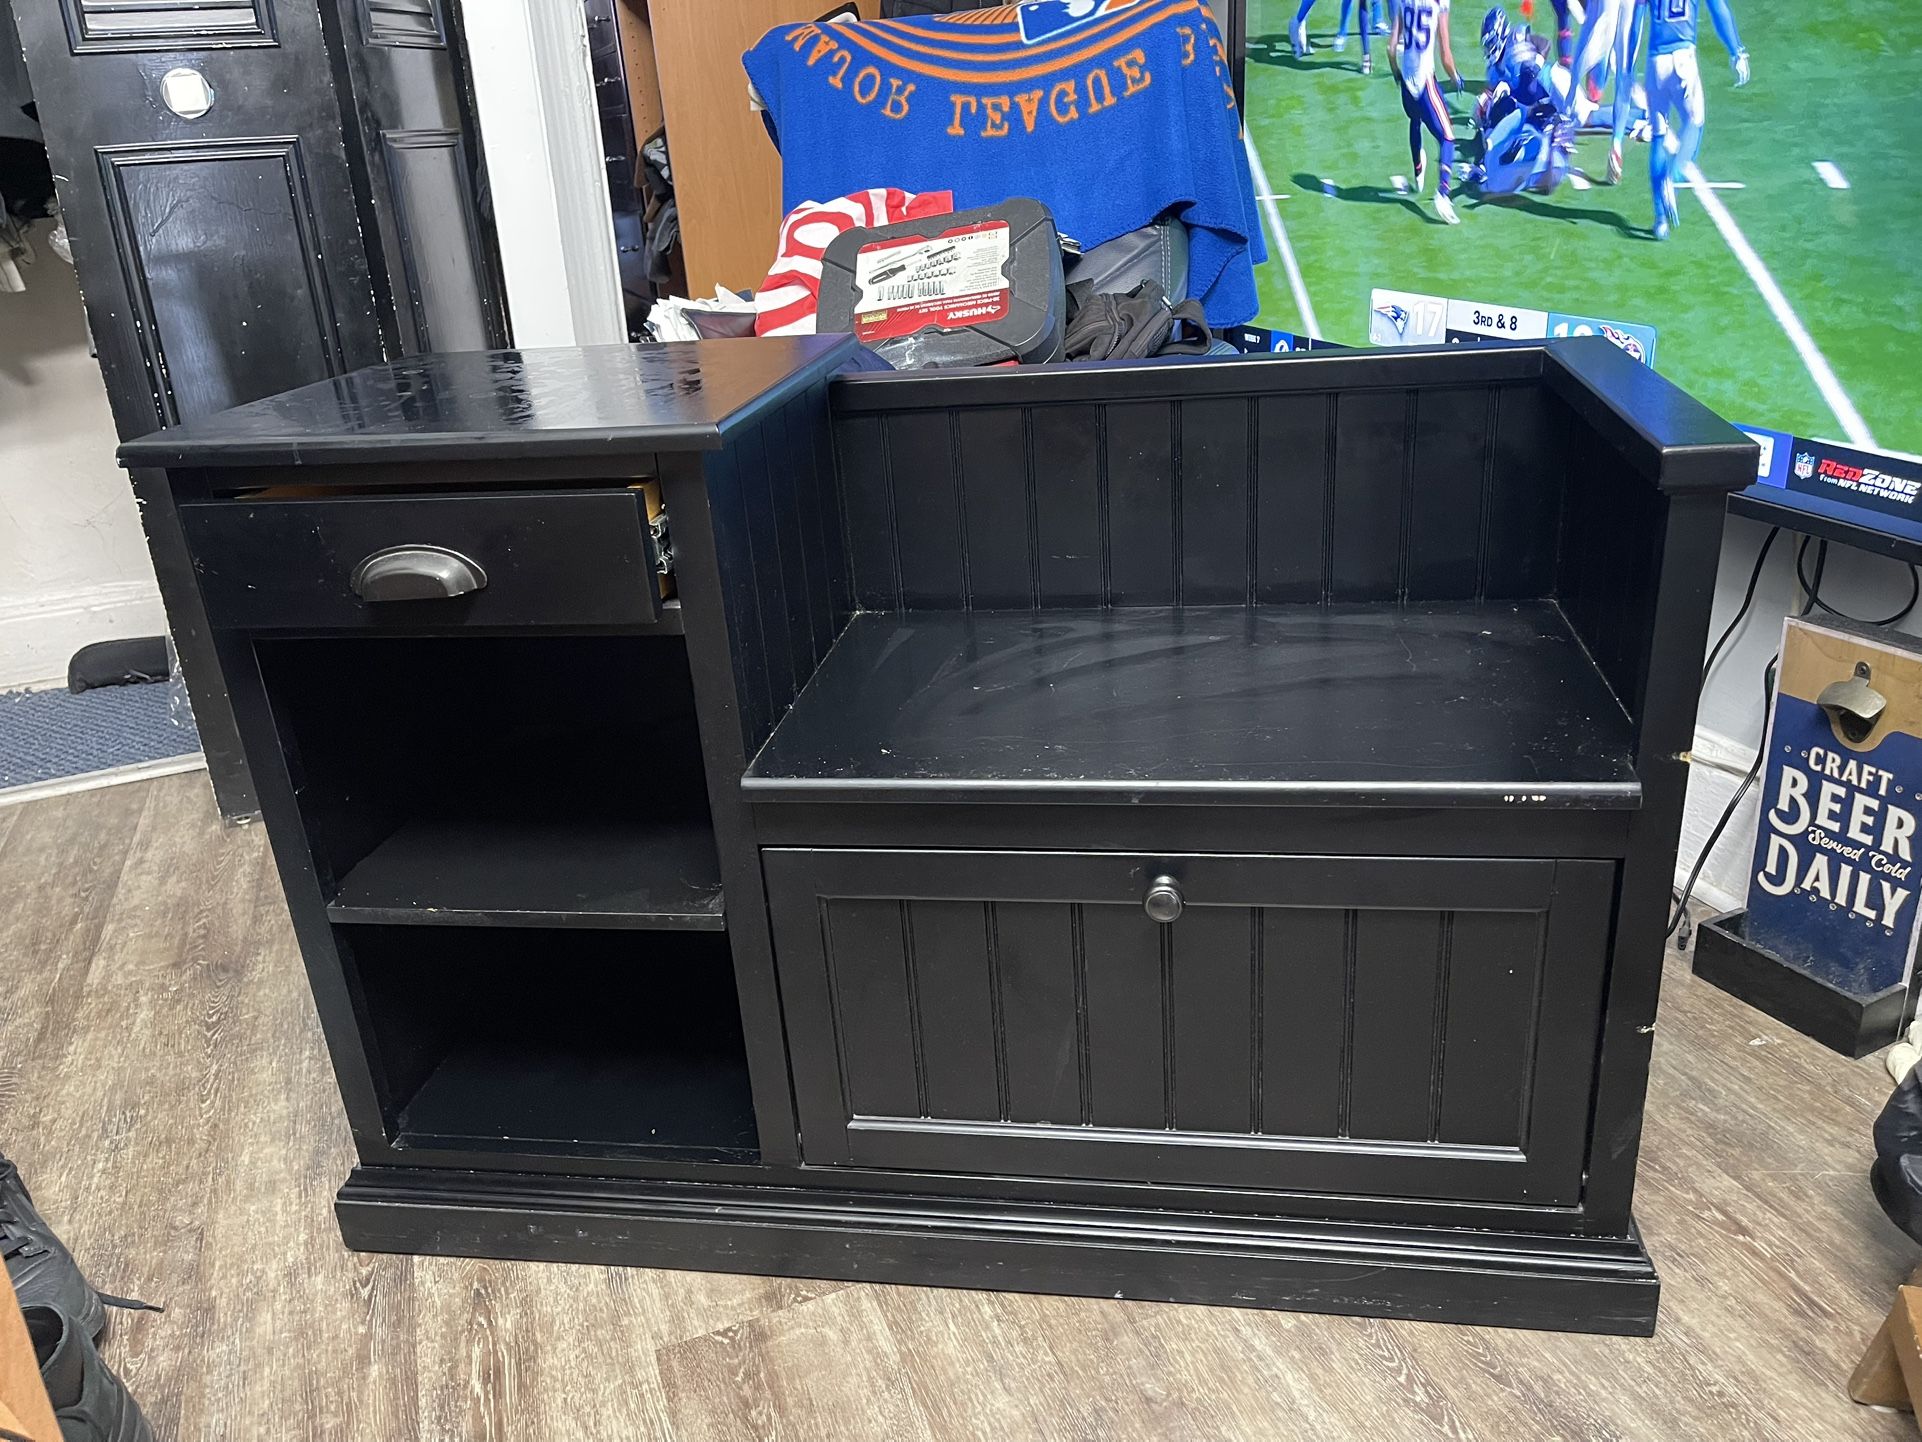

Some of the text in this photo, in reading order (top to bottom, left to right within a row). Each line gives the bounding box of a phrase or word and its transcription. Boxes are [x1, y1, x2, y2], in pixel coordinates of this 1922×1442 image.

[1403, 6, 1433, 53] 85
[946, 306, 987, 320] HUSKY
[1412, 301, 1444, 338] 17
[1472, 310, 1519, 331] 3RD & 8
[1837, 478, 1858, 492] NFL
[1858, 484, 1916, 504] NETWORK
[1808, 745, 1894, 797] CRAFT
[1768, 764, 1918, 863] BEER
[1807, 826, 1912, 882] Served Cold
[1757, 832, 1912, 929] DAILY
